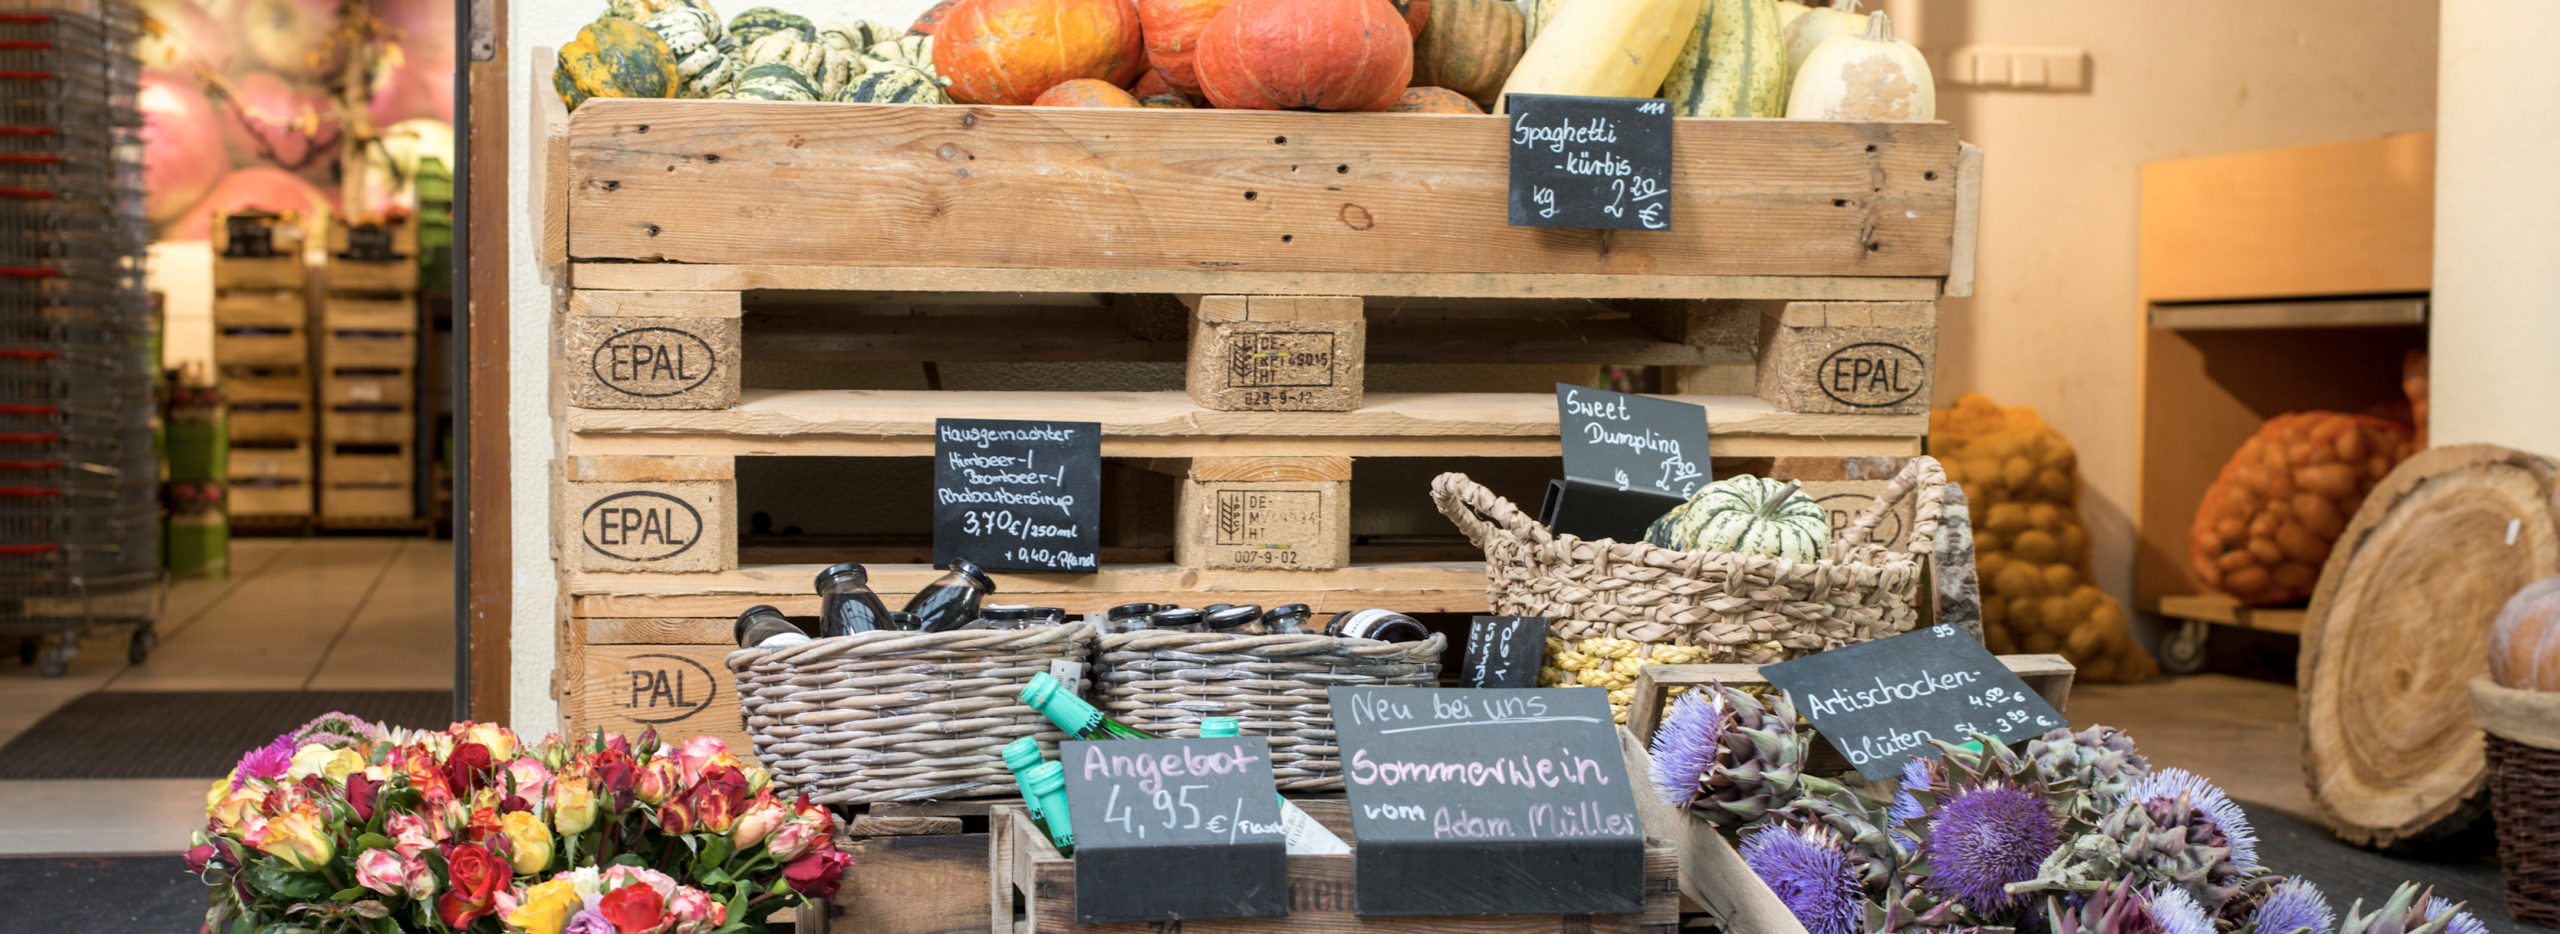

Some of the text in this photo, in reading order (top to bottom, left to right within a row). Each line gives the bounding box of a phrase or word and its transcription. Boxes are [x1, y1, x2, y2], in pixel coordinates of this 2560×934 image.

[1512, 112, 1617, 153] Spaghetti
[1554, 151, 1632, 176] -kürbis
[1533, 184, 1561, 218] kg
[612, 343, 697, 381] EPAL
[1833, 357, 1909, 393] EPAL
[1566, 389, 1631, 421] Sweet
[940, 424, 1075, 449] Hausgemachter
[1583, 421, 1683, 464] Dumpling
[937, 486, 1074, 516] Rhabarbersirup
[600, 507, 685, 546] EPAL
[1249, 528, 1266, 540] HT
[1057, 551, 1096, 570] Pfand
[1234, 550, 1298, 565] 007-9-02
[1931, 623, 1956, 638] 95
[1351, 690, 1548, 726] Neu bei uns
[1807, 669, 1982, 720] Artischocken-
[1840, 727, 1933, 765] blüten
[1083, 744, 1260, 795] Angebot
[1363, 801, 1635, 839] vom Adam Müller
